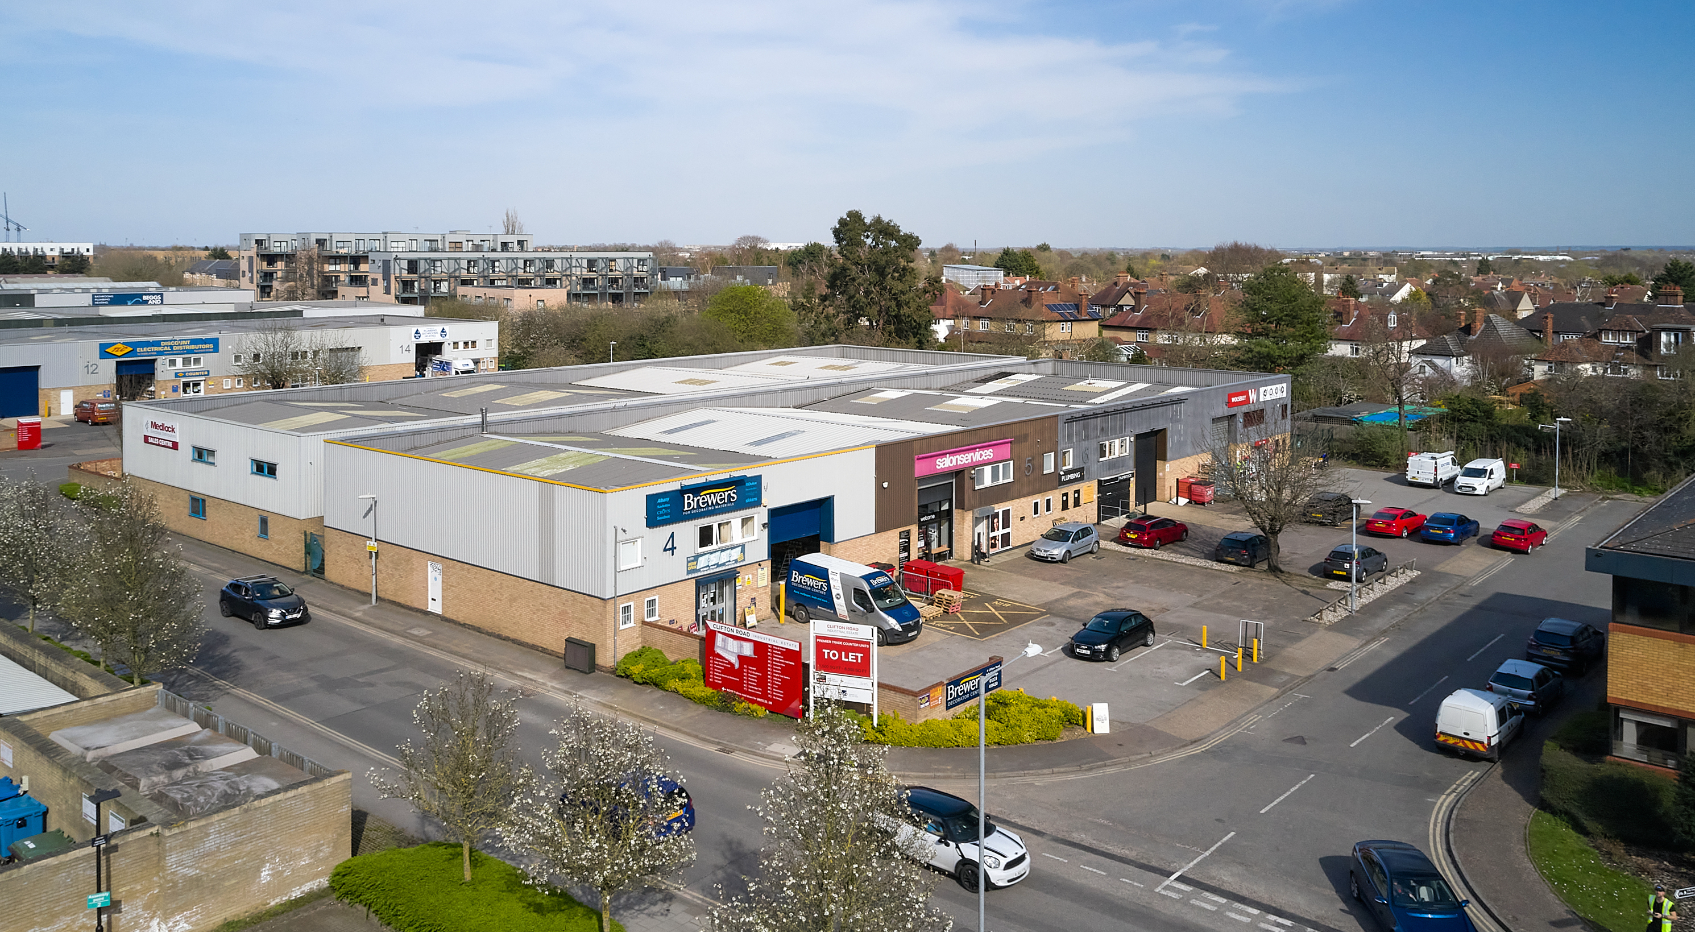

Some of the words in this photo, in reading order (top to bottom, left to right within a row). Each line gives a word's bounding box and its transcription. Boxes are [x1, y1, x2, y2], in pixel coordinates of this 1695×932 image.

[399, 344, 411, 354] 14
[84, 363, 99, 375] 12
[151, 421, 175, 433] Medlock
[936, 448, 993, 469] salonservices
[1061, 471, 1081, 482] PLUMBING
[683, 489, 738, 511] Brewers
[920, 514, 936, 522] welcome
[663, 531, 677, 556] 4
[791, 570, 828, 591] Brewers
[870, 576, 889, 586] Brewers
[712, 623, 735, 634] CLIFTON
[735, 628, 751, 638] ROAD
[822, 649, 839, 660] TO
[841, 651, 864, 663] LET
[947, 677, 980, 701] Brewer
[947, 693, 970, 707] DECORATOR
